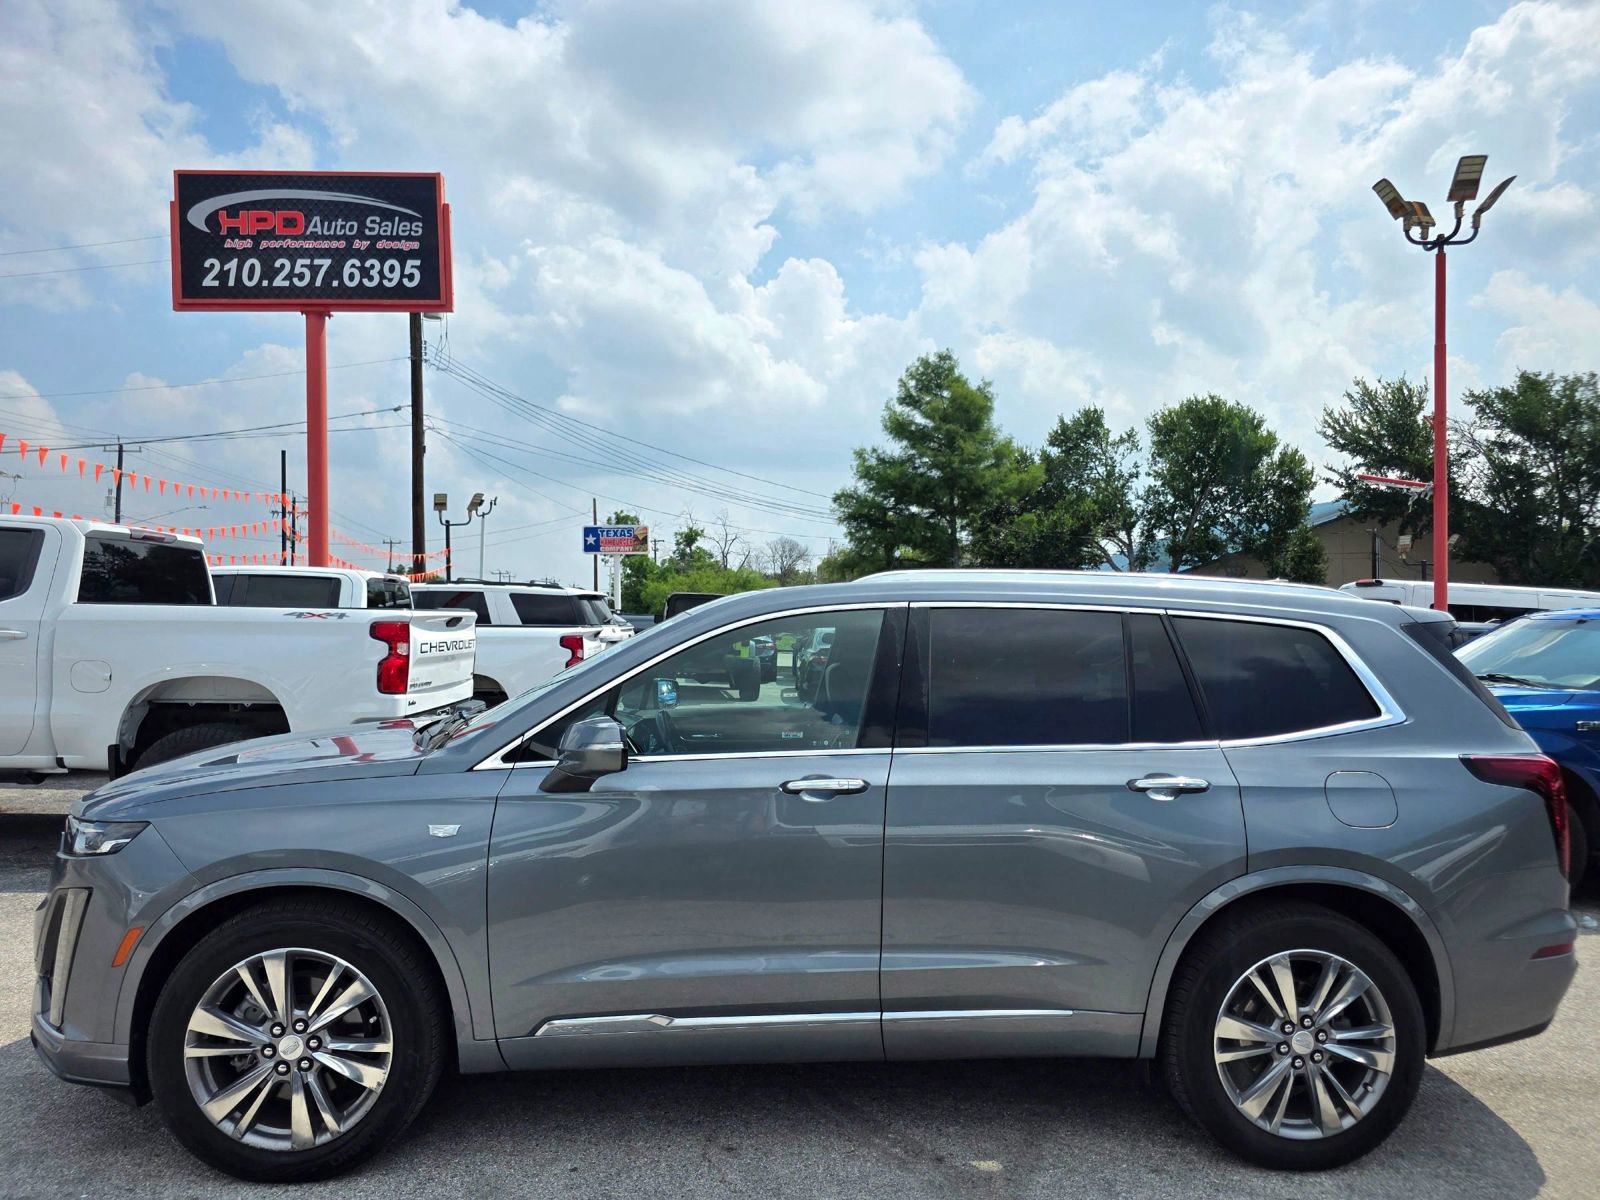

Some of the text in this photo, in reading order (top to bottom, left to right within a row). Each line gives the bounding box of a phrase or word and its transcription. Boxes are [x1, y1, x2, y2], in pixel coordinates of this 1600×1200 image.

[218, 210, 422, 237] HPD Auto Sales
[224, 239, 420, 251] high performance by design
[202, 258, 421, 288] 210.257.6395
[598, 529, 633, 538] TEXAS
[420, 639, 476, 654] CHEVROLET
